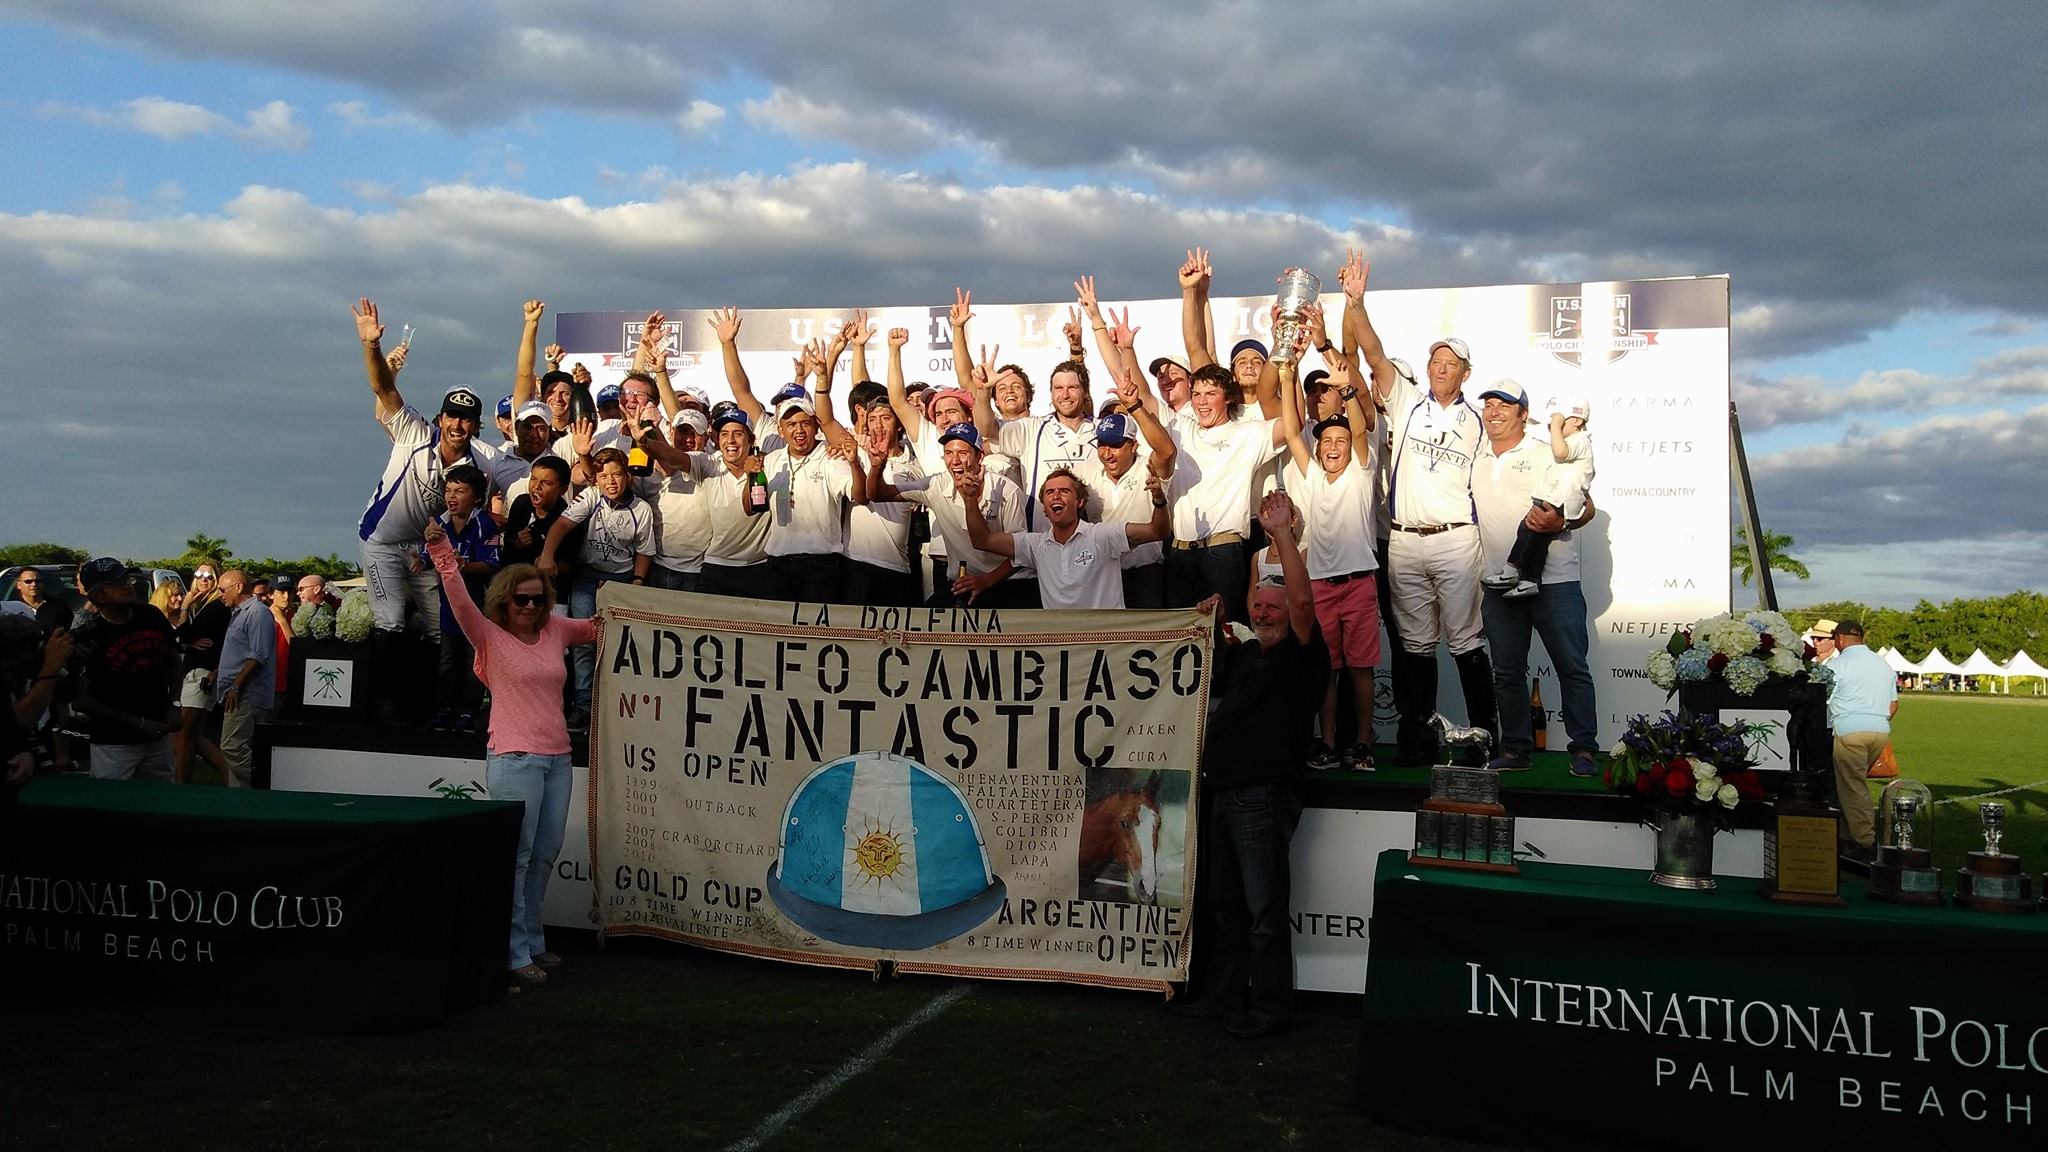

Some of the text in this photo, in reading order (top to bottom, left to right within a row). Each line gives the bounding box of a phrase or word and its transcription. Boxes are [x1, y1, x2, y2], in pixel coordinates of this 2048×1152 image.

[1611, 441, 1693, 456] NETJETS
[1611, 487, 1696, 497] TOWN&COUNTRY
[792, 602, 1002, 633] LA DOLFINA
[612, 625, 1202, 702] ADOLFO CAMBIASO
[685, 686, 1115, 771] FANTASTIC
[1126, 723, 1176, 736] AIKEN
[623, 743, 768, 787] US OPEN
[1128, 751, 1168, 763] CURA
[957, 772, 1084, 786] BUENAVENTURA
[625, 789, 657, 804] 2000
[975, 798, 1084, 811] CUARTETERA
[625, 801, 656, 817] 2001
[685, 798, 758, 818] OUTBACK
[625, 823, 656, 839] 2007
[995, 825, 1069, 839] COLIBRI
[1005, 839, 1058, 852] DIOSA
[1010, 854, 1049, 868] LAPA
[615, 864, 763, 913] GOLD CUP
[647, 898, 677, 915] TIME
[691, 907, 753, 928] WINNER
[998, 898, 1182, 936] ARGENTINE
[6, 922, 215, 962] PALM BEACH
[968, 935, 975, 947] 8
[1097, 934, 1182, 968] OPEN
[1465, 962, 1892, 1059] INTERNATIONAL
[1655, 1057, 2033, 1126] PALM BEACH
